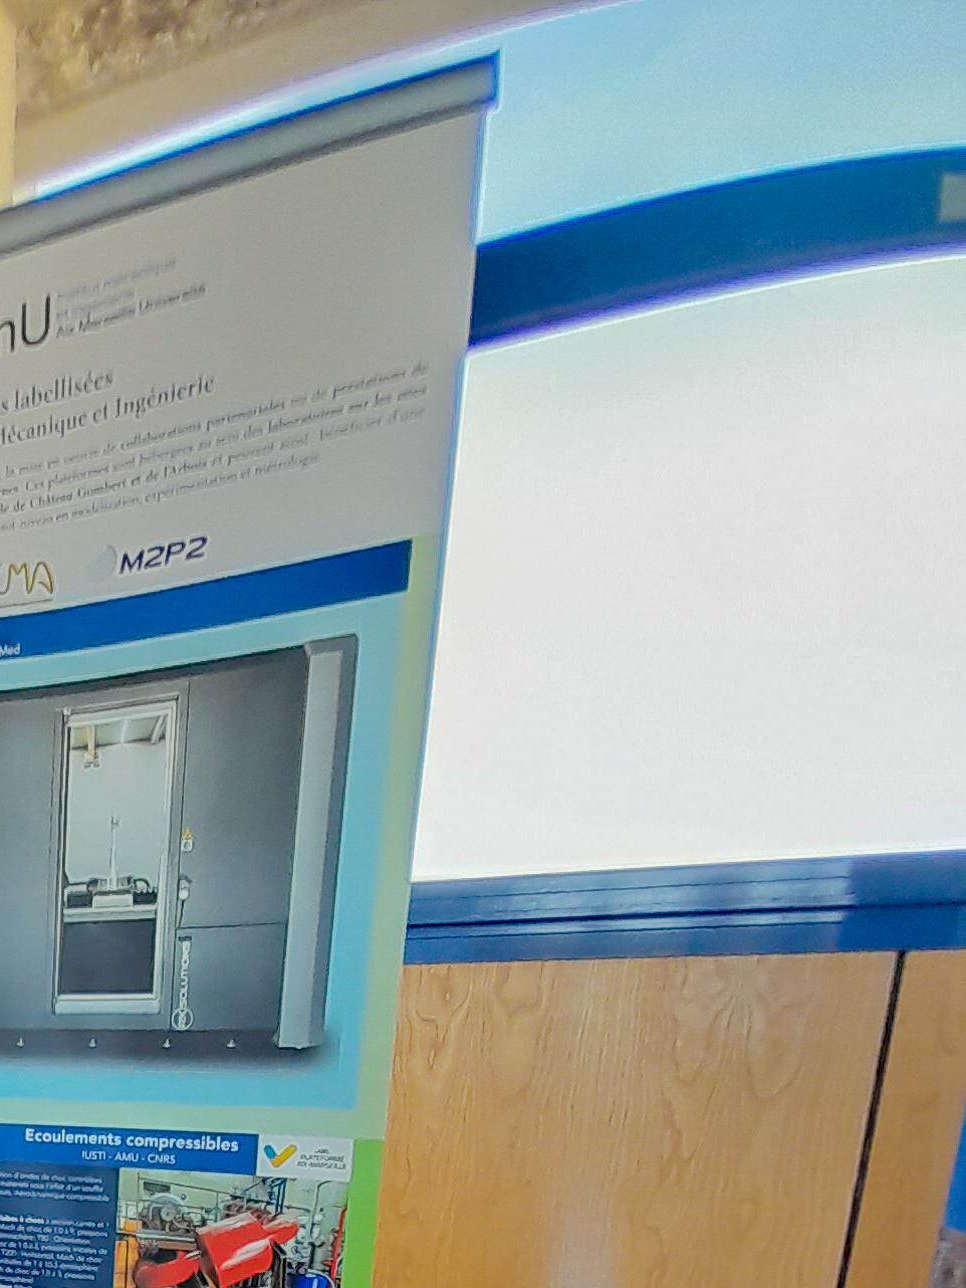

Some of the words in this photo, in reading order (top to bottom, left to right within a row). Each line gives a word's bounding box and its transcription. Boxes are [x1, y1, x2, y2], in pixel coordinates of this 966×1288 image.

[15, 370, 113, 412] labellisées
[93, 402, 108, 424] et
[115, 375, 215, 419] Ingénierie
[119, 536, 208, 574] M2P2
[25, 1127, 122, 1146] Ecoulements
[126, 1134, 239, 1152] compressibles
[82, 1150, 106, 1161] IUSTI
[114, 1152, 139, 1163] AMU
[147, 1153, 176, 1165] CNRS
